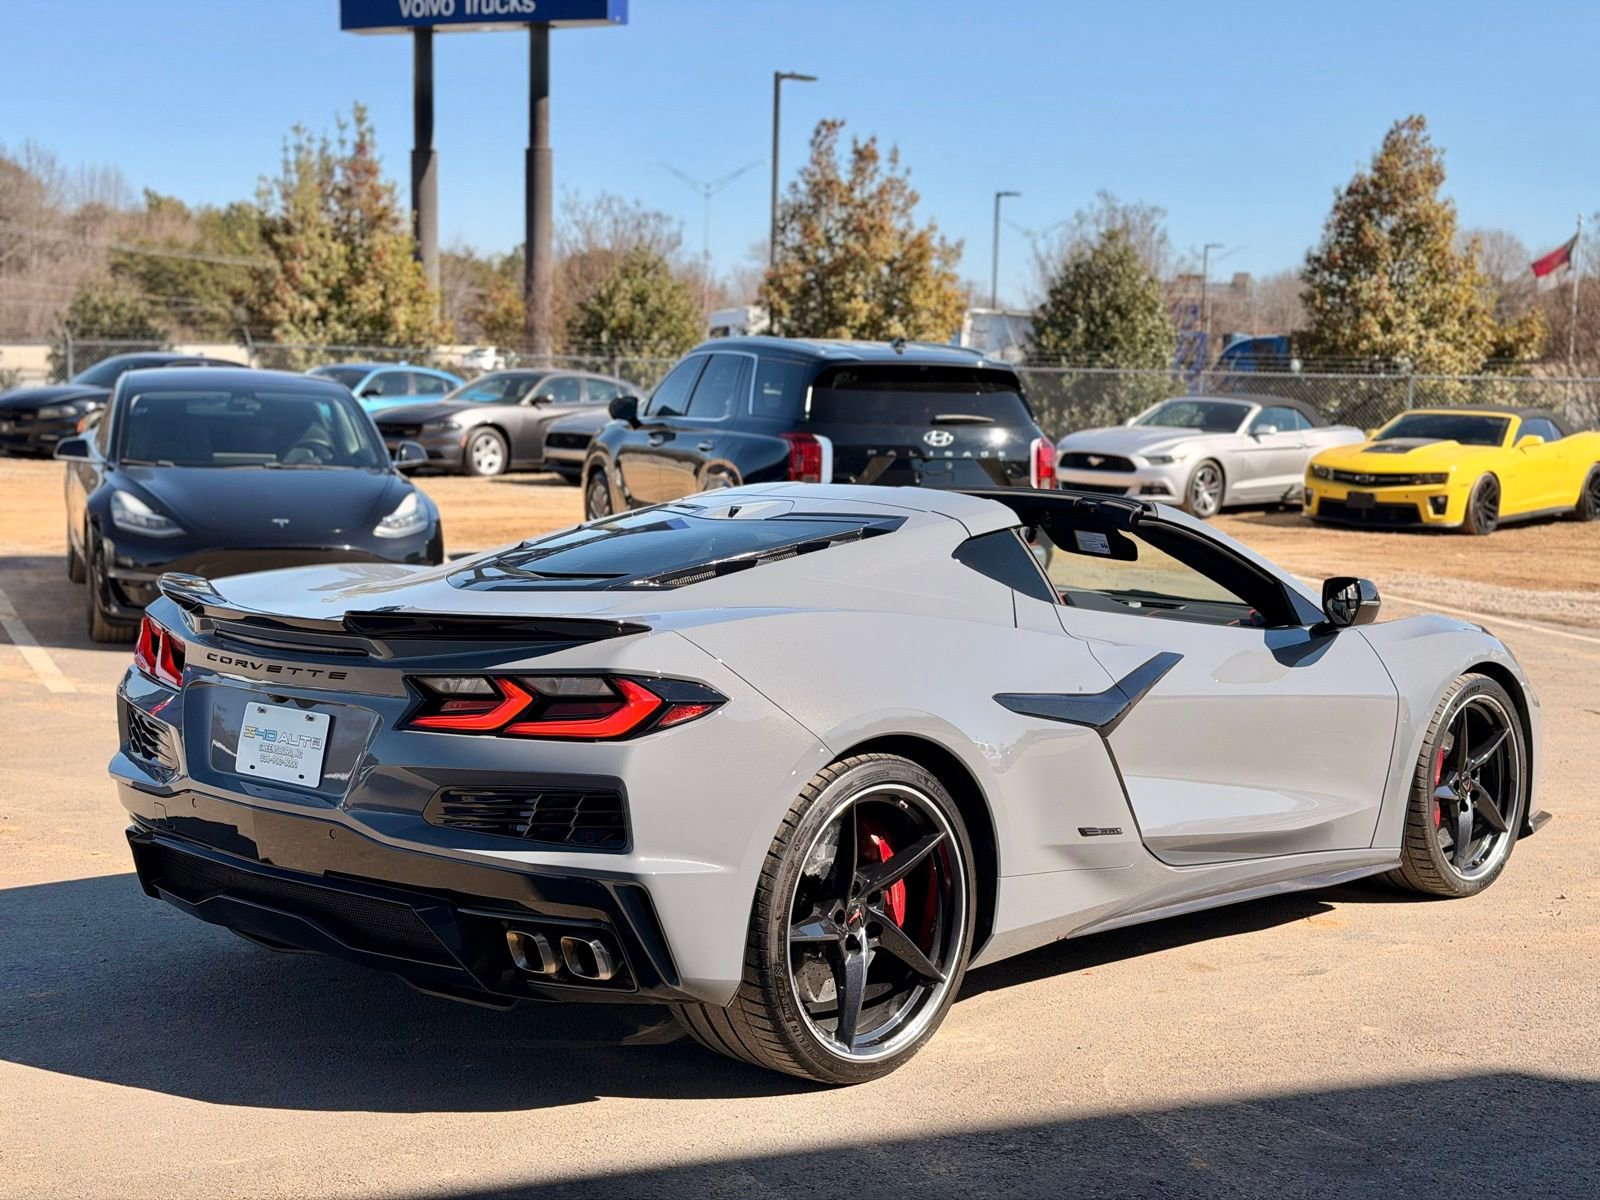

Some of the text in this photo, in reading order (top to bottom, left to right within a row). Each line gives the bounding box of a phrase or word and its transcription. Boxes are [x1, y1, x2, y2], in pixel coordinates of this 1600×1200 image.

[399, 0, 536, 18] Volvo Trucks
[206, 652, 347, 680] CORVETTE
[278, 732, 322, 750] AUTO
